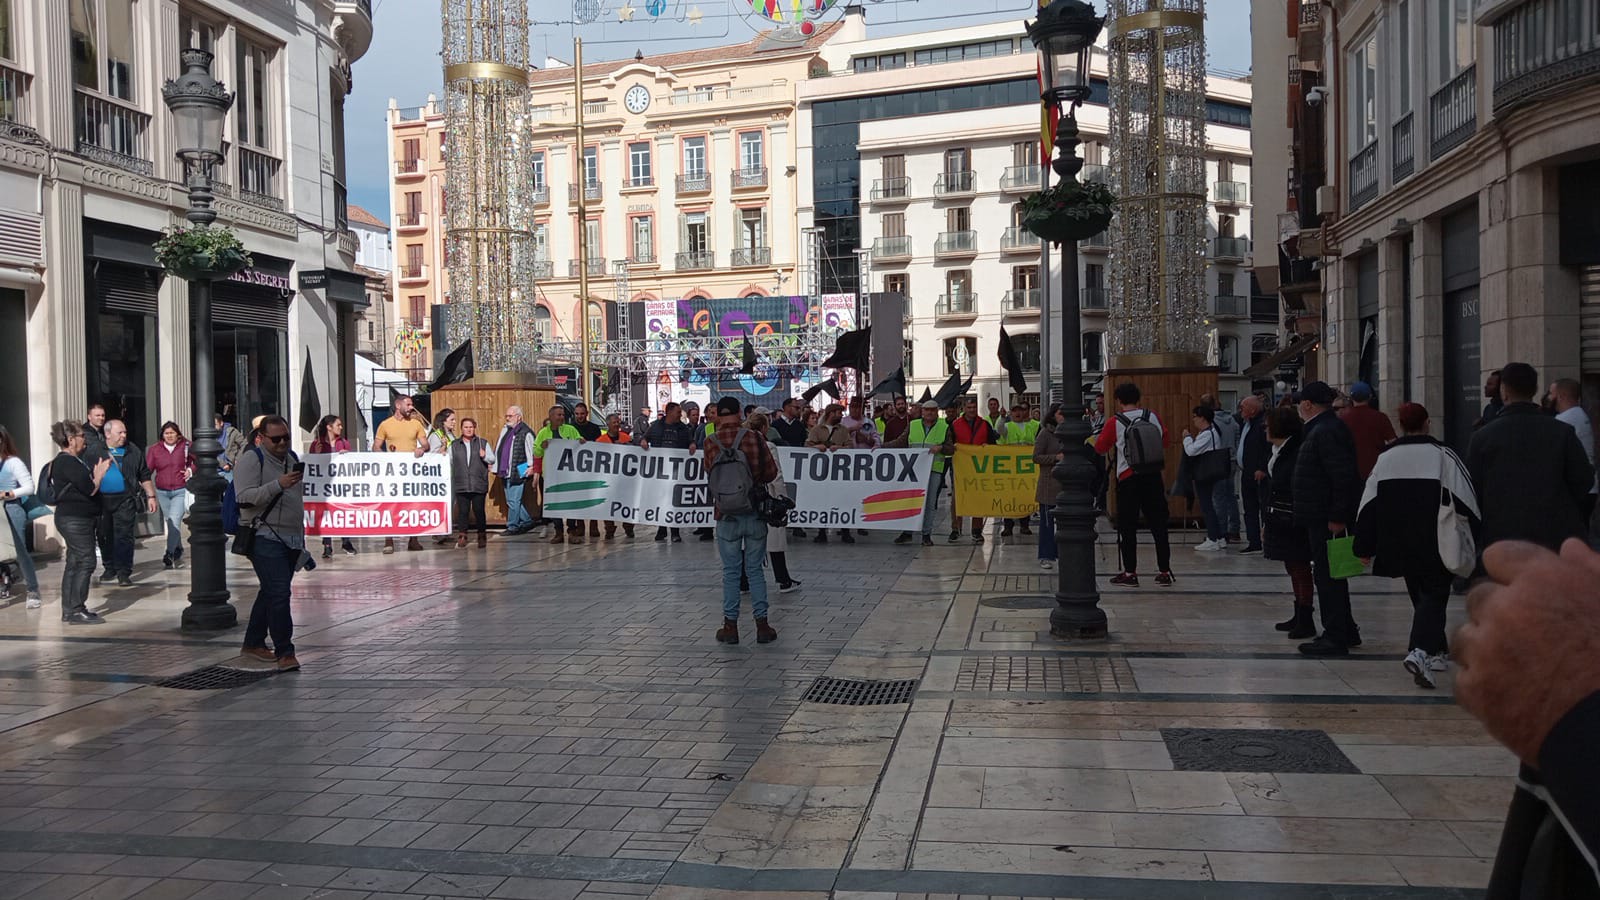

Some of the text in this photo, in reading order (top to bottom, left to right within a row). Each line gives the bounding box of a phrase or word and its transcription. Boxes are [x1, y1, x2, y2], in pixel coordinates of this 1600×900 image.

[254, 271, 289, 288] SECRET
[308, 461, 442, 477] EL CAMPO A 3 Cént
[790, 453, 919, 482] TORROX
[303, 483, 447, 497] EL SUPER A 3 EUROS
[681, 487, 708, 505] EN
[321, 509, 393, 528] AGENDA
[398, 510, 441, 528] 2030
[610, 501, 857, 525] Por el sector español
